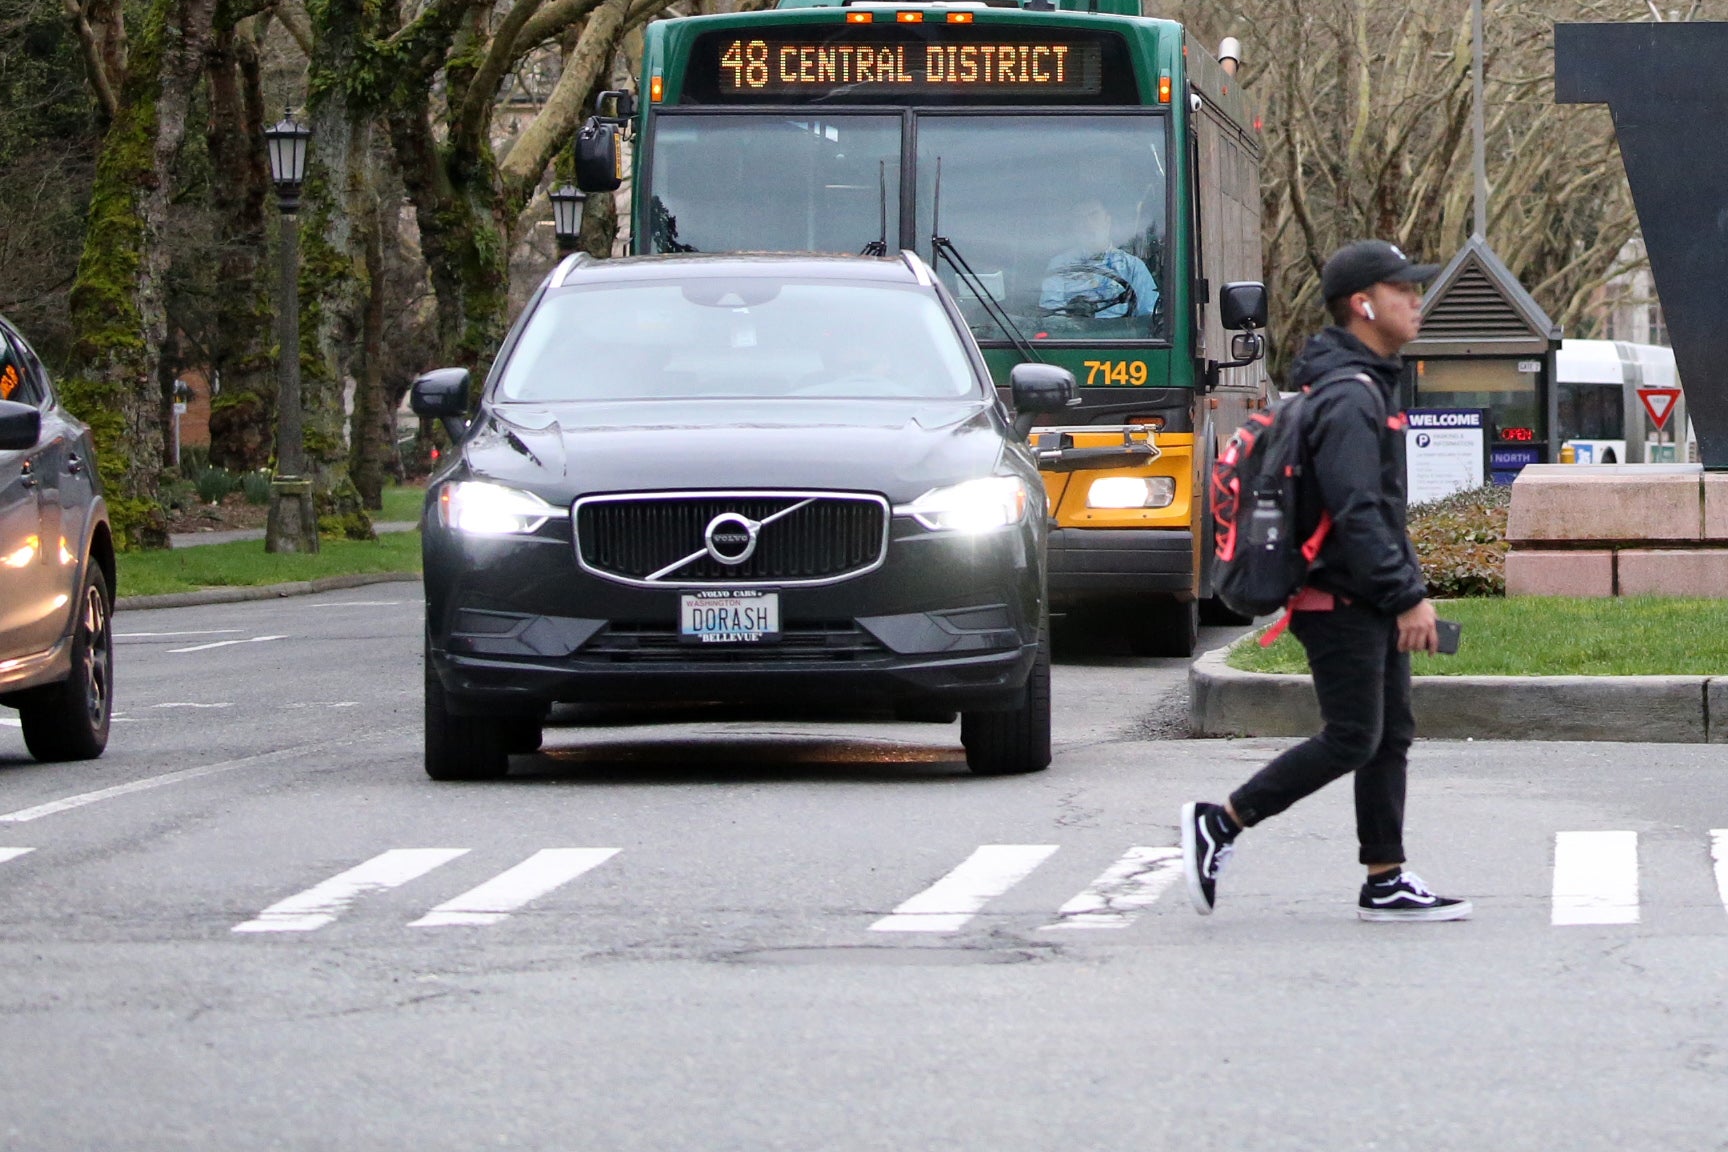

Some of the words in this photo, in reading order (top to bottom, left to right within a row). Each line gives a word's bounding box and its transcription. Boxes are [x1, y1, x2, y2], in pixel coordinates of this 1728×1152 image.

[720, 40, 768, 88] 48
[778, 46, 913, 82] CENTRAL
[926, 45, 1069, 82] DISTRICT
[1083, 360, 1148, 385] 7149
[1409, 413, 1480, 426] WELCOME
[1495, 453, 1531, 463] NORTH
[713, 534, 749, 542] VOLVO
[686, 599, 741, 607] WASHINGTON
[693, 607, 768, 631] DORASH
